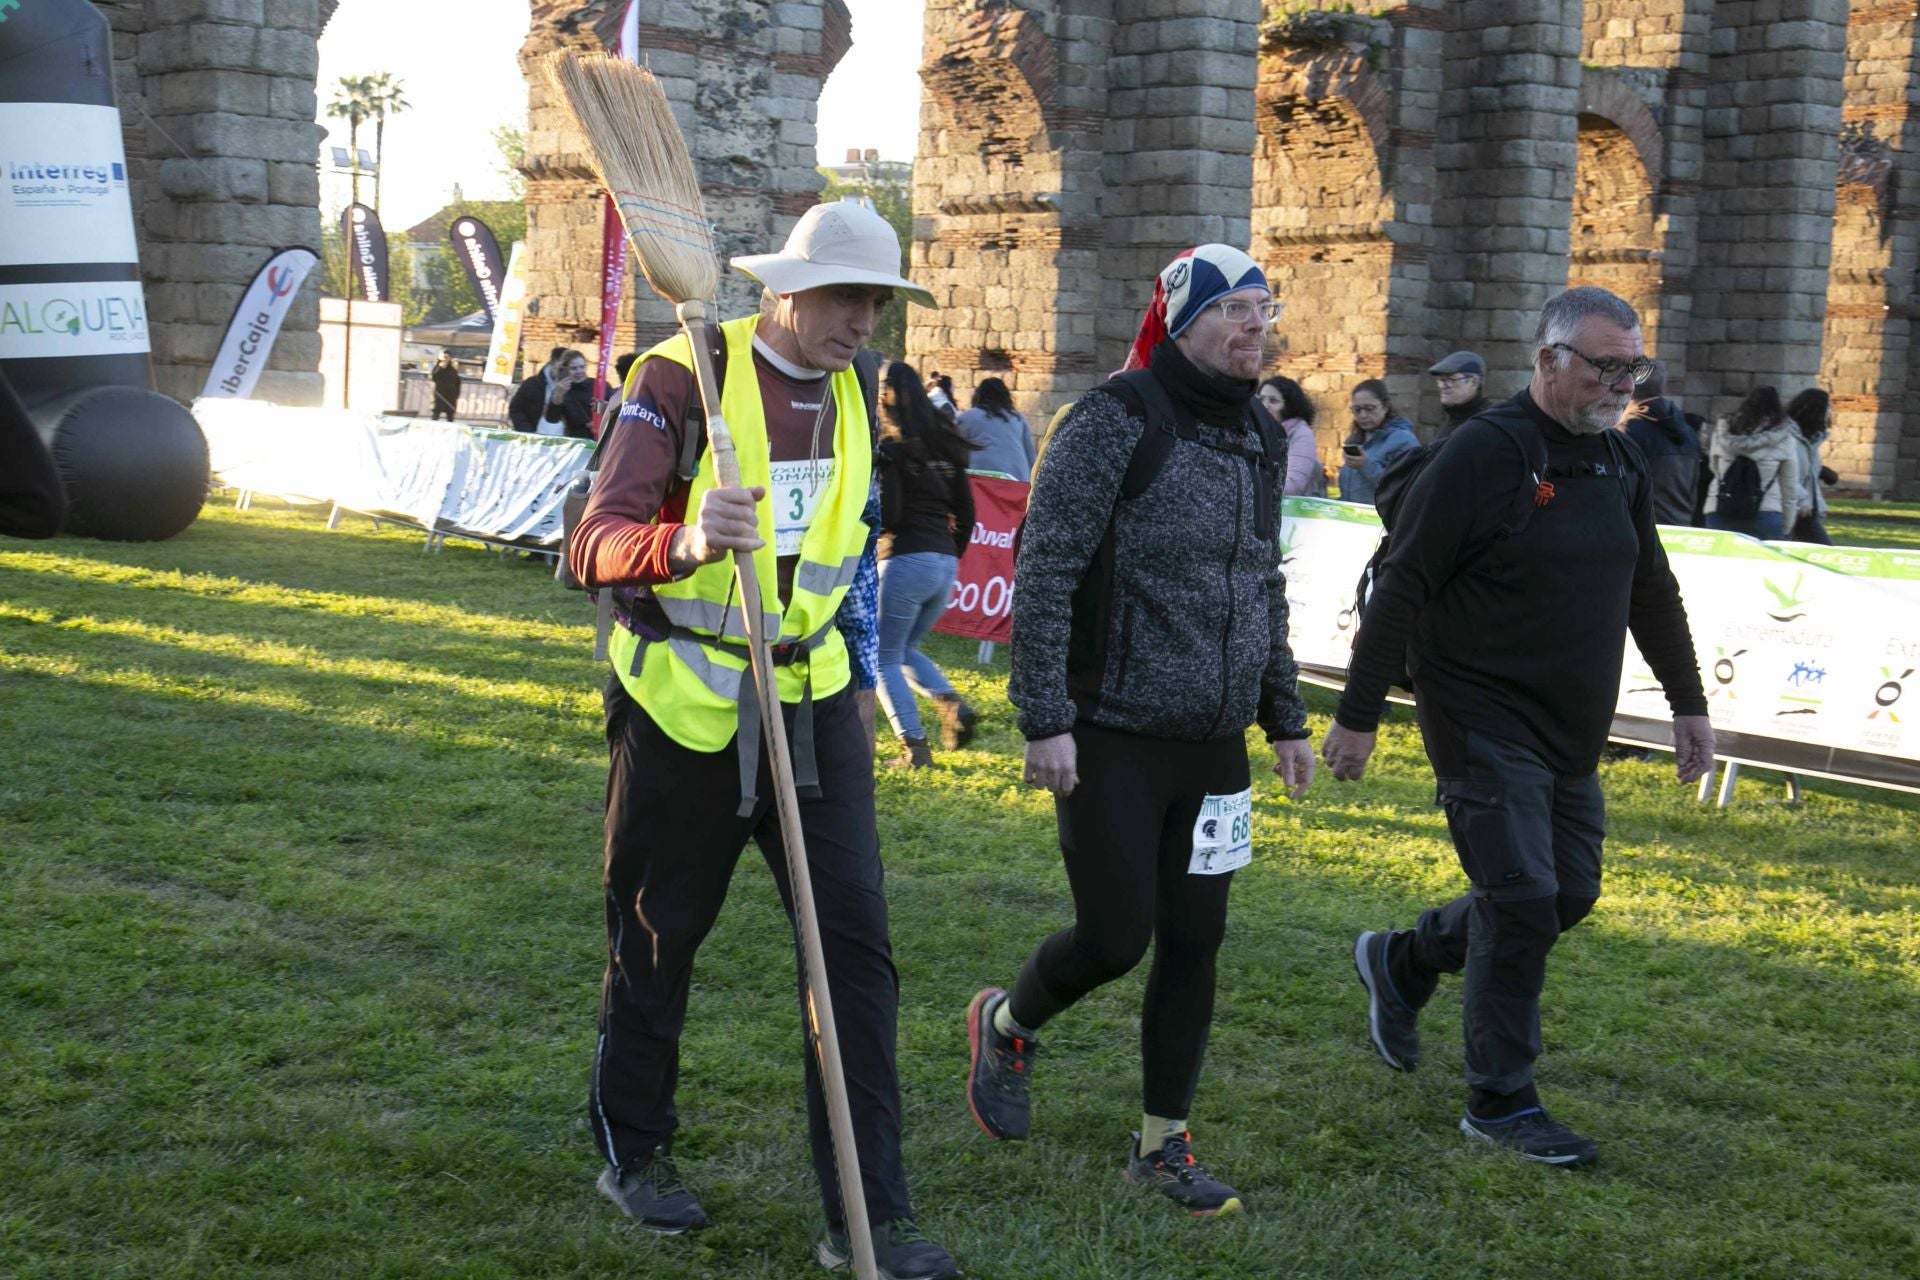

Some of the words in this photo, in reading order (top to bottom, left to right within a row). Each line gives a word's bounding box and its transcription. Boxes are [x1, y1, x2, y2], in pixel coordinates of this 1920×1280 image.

[10, 161, 107, 183] Interreg
[789, 488, 804, 521] 3
[970, 521, 1017, 549] Duval
